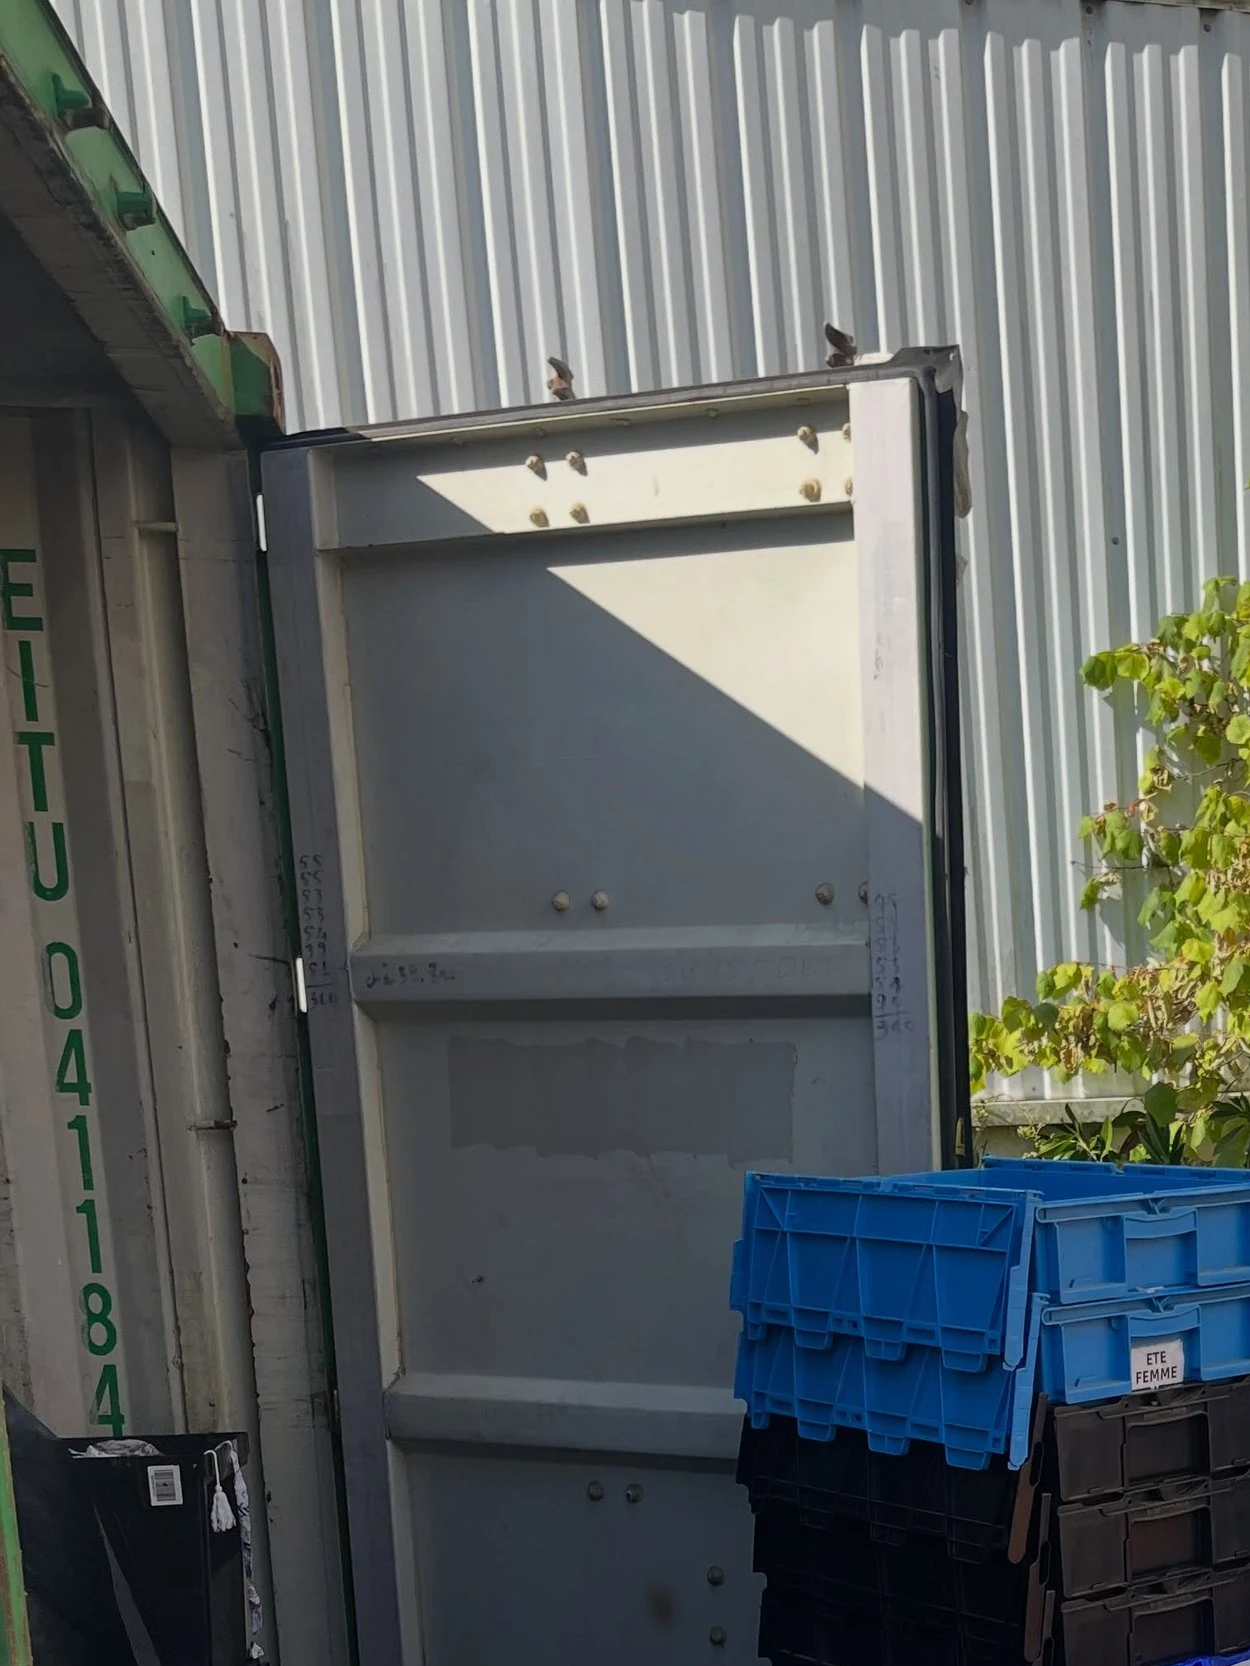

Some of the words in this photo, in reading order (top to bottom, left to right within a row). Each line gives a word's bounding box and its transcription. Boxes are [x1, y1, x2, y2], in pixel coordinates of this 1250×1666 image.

[0, 548, 68, 902] EITU
[44, 941, 125, 1437] 041184
[1146, 1351, 1167, 1366] ETE
[1136, 1366, 1178, 1384] FEMME
